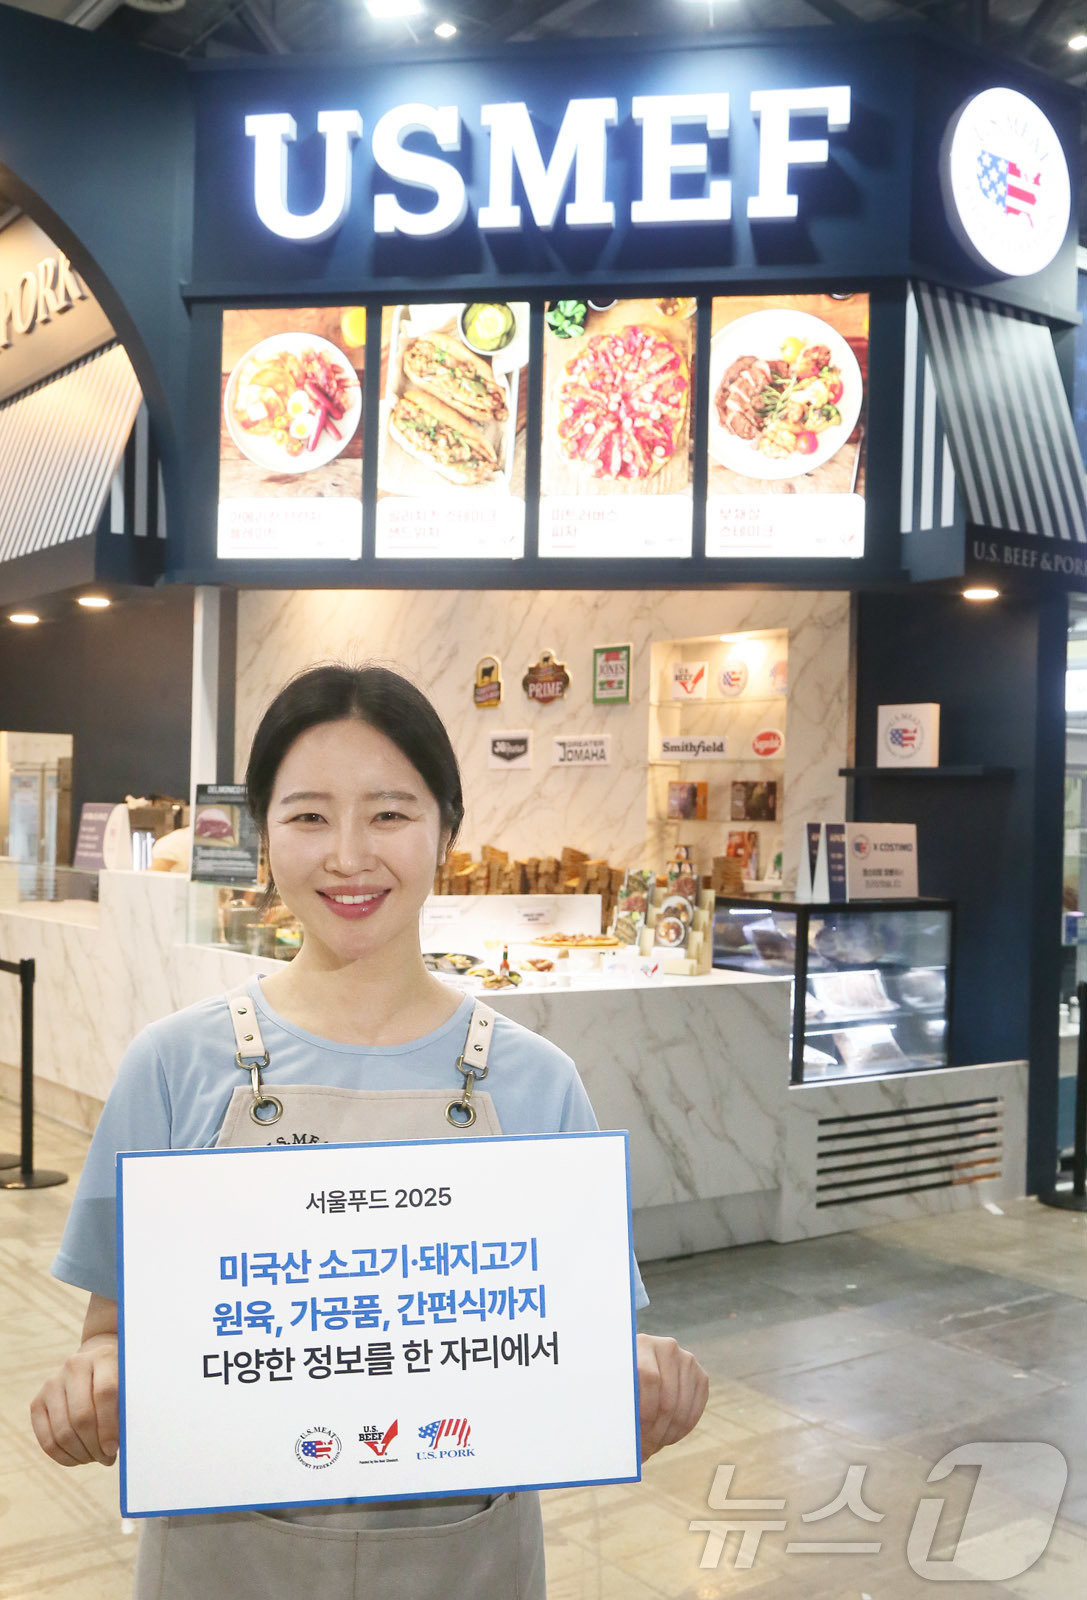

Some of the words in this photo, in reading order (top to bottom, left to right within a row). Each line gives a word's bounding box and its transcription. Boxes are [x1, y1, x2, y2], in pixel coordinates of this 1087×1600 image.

[244, 85, 851, 241] USMEF
[973, 540, 1000, 563] U.S.
[1003, 546, 1038, 568] BEEF
[528, 681, 564, 698] PRIME
[662, 740, 724, 757] Smithfield
[305, 1189, 389, 1214] 서울푸드
[394, 1186, 452, 1210] 2025
[219, 1249, 312, 1287] 미국산
[212, 1299, 284, 1338] 원육,
[289, 1292, 392, 1332] 가공품,
[397, 1284, 547, 1328] 간편식까지
[202, 1348, 295, 1386] 다양한
[302, 1341, 394, 1380] 정보를
[402, 1340, 433, 1374] 한
[440, 1331, 560, 1370] 자리에서
[358, 1432, 384, 1441] BEEF
[363, 1425, 378, 1433] U.S.
[416, 1451, 437, 1461] U.S.
[439, 1448, 476, 1459] PORK
